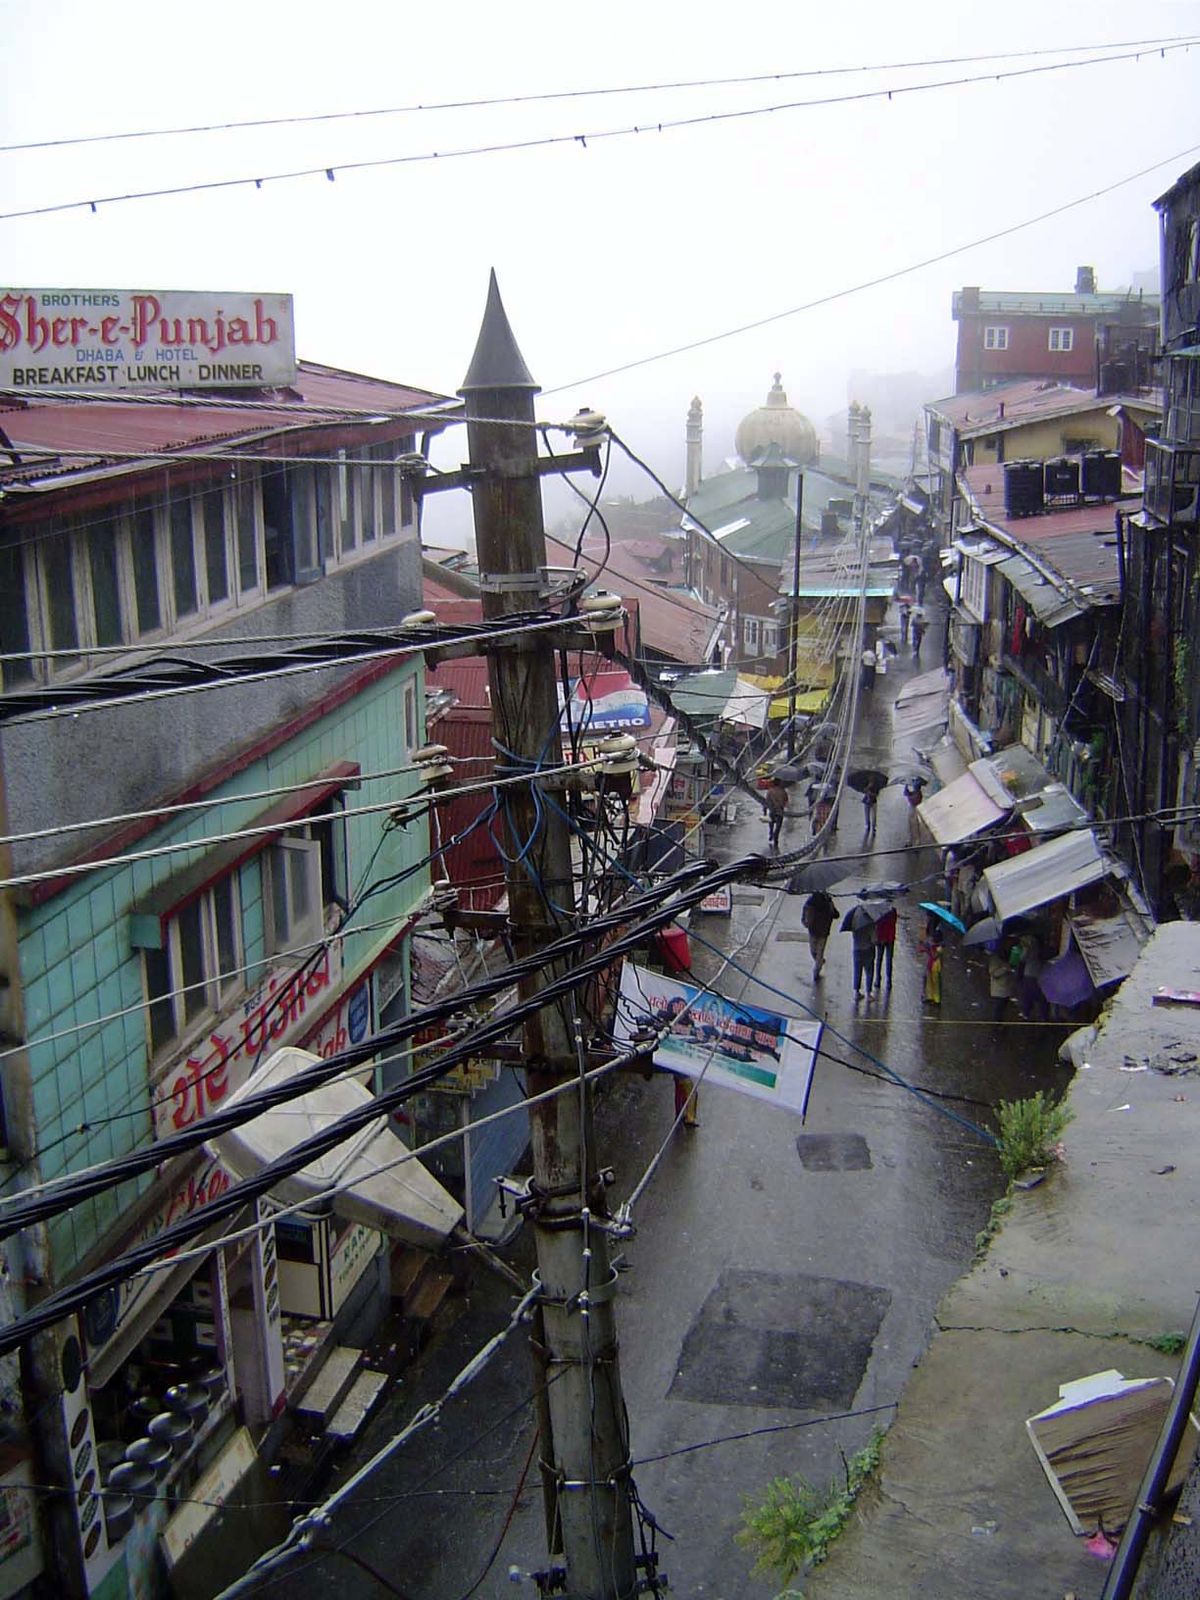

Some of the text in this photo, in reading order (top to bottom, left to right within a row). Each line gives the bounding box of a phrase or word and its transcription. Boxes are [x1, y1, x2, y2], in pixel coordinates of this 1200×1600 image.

[42, 295, 120, 307] BROTHERS
[0, 293, 278, 355] Sher-e-Punjab
[76, 349, 125, 362] DHABA
[156, 349, 198, 361] HOTEL
[13, 364, 264, 386] BREAKFAST LUNCH DINNER
